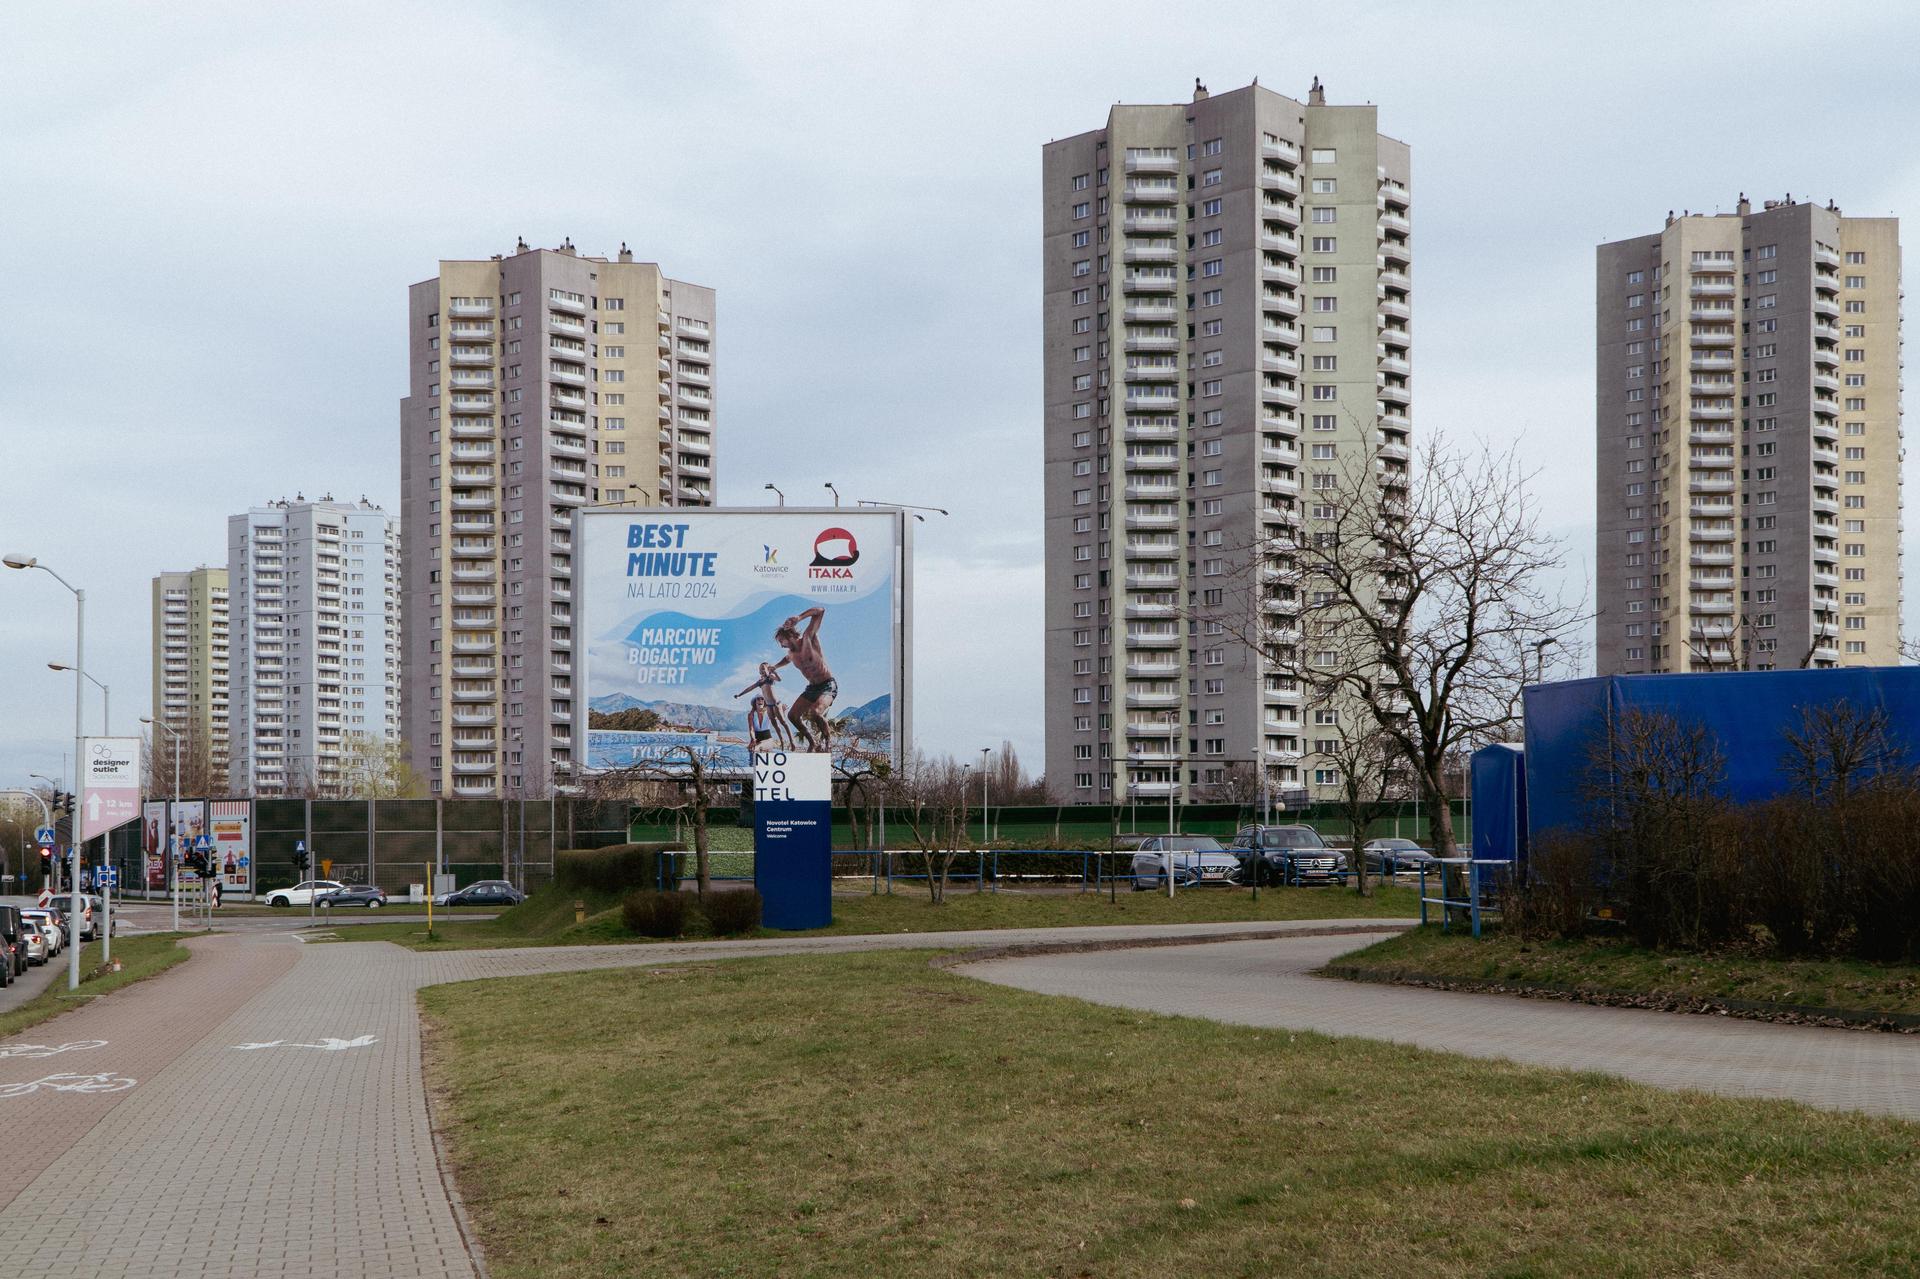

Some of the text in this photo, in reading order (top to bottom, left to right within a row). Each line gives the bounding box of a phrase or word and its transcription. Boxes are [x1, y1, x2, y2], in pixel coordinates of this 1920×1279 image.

[627, 524, 690, 548] BEST
[627, 552, 718, 577] MINUTE
[753, 564, 789, 573] Katowice
[809, 567, 854, 579] ITAKA
[627, 582, 717, 599] NA LATO 2024
[811, 584, 857, 593] WWW.ITAKA.PL
[641, 628, 722, 646] MARCOWE
[629, 648, 717, 665] BOGACTWO
[638, 666, 689, 684] OFERT
[92, 758, 130, 767] designer
[755, 752, 787, 766] NO
[756, 770, 786, 784] VO
[755, 787, 795, 801] TEL
